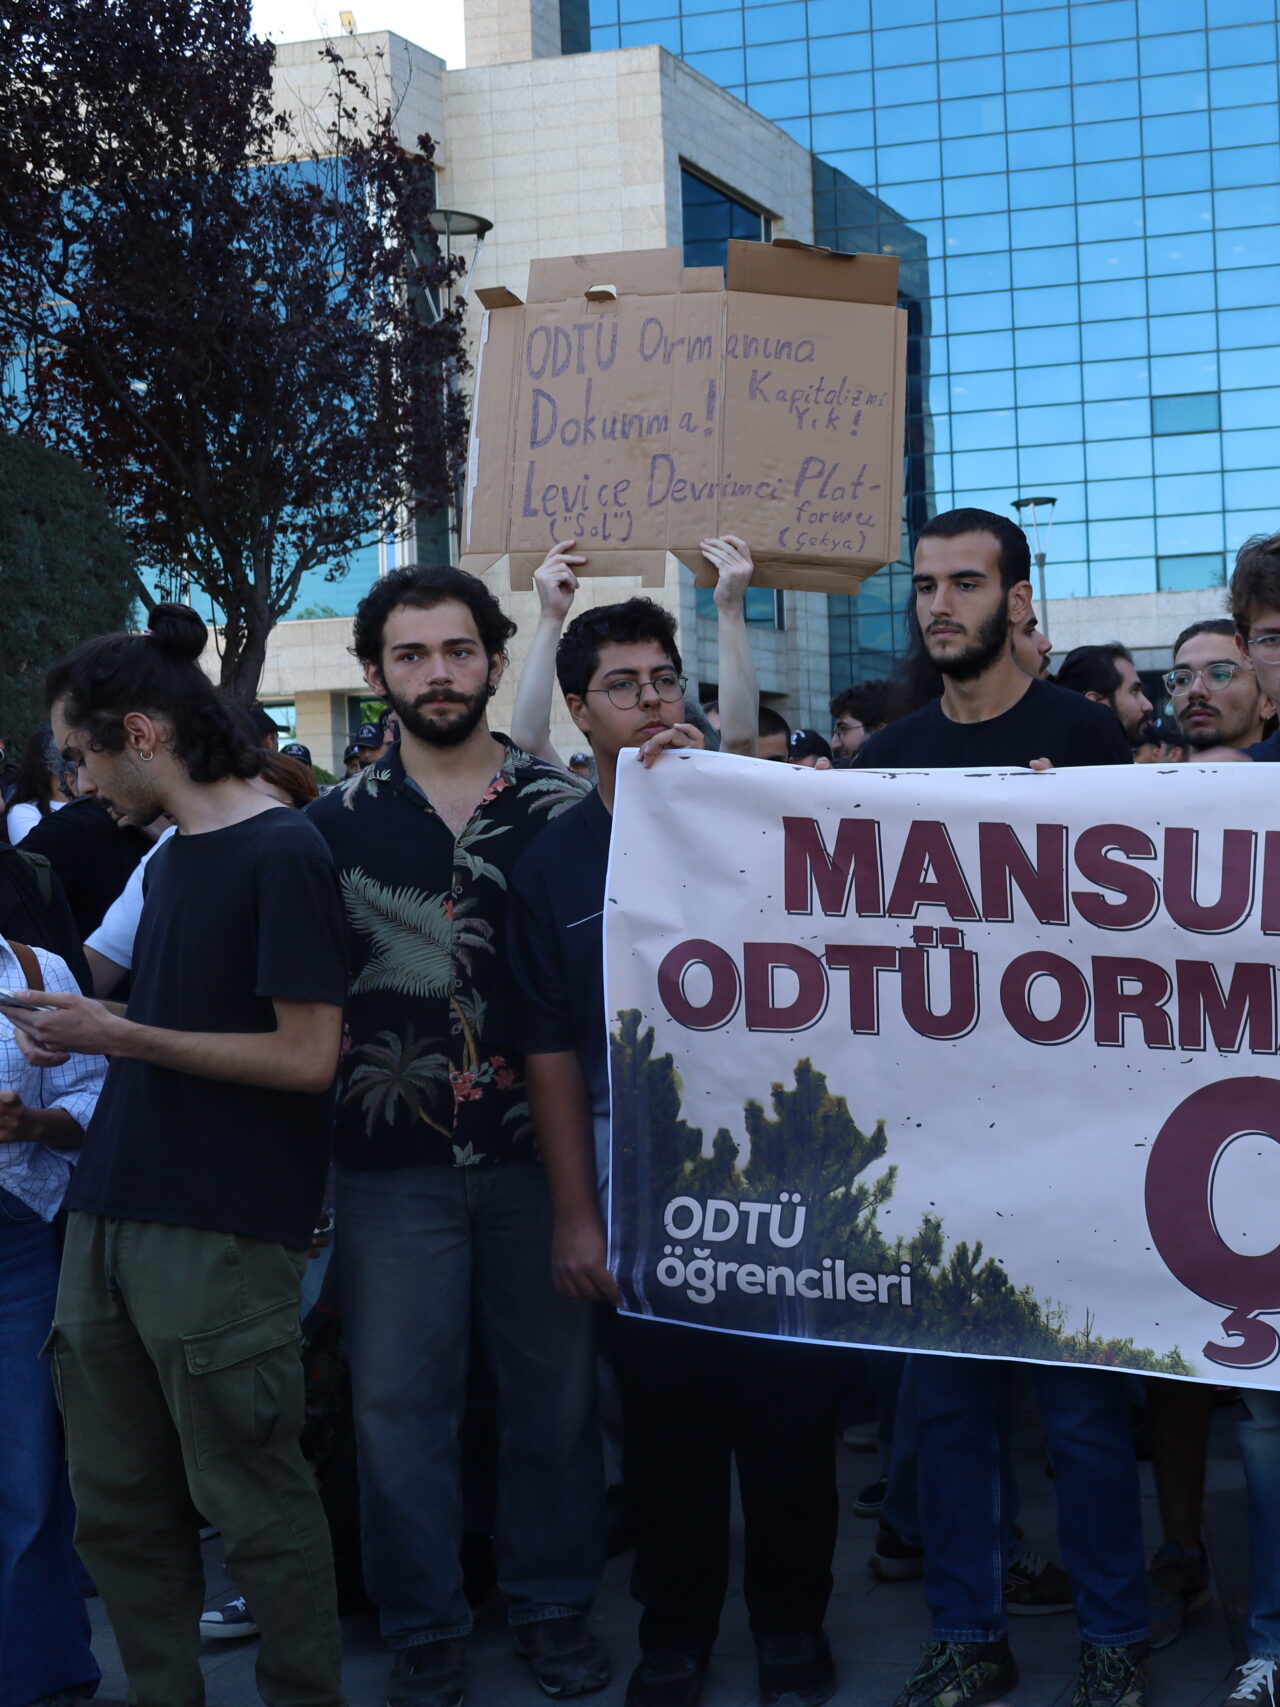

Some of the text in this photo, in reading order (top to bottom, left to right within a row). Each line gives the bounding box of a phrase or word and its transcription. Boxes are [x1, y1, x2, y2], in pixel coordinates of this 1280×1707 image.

[526, 313, 816, 380] ODTÜ Ormanına
[530, 377, 716, 449] Dokunma!
[749, 369, 888, 413] Kapitalizmi
[795, 405, 863, 437] Yık!
[522, 453, 881, 518] Levice Devrimci Plat-
[778, 527, 867, 554] (Çekya)
[657, 926, 980, 1041] ODTÜ
[663, 1191, 807, 1248] ODTÜ
[656, 1244, 912, 1306] öğrencileri
